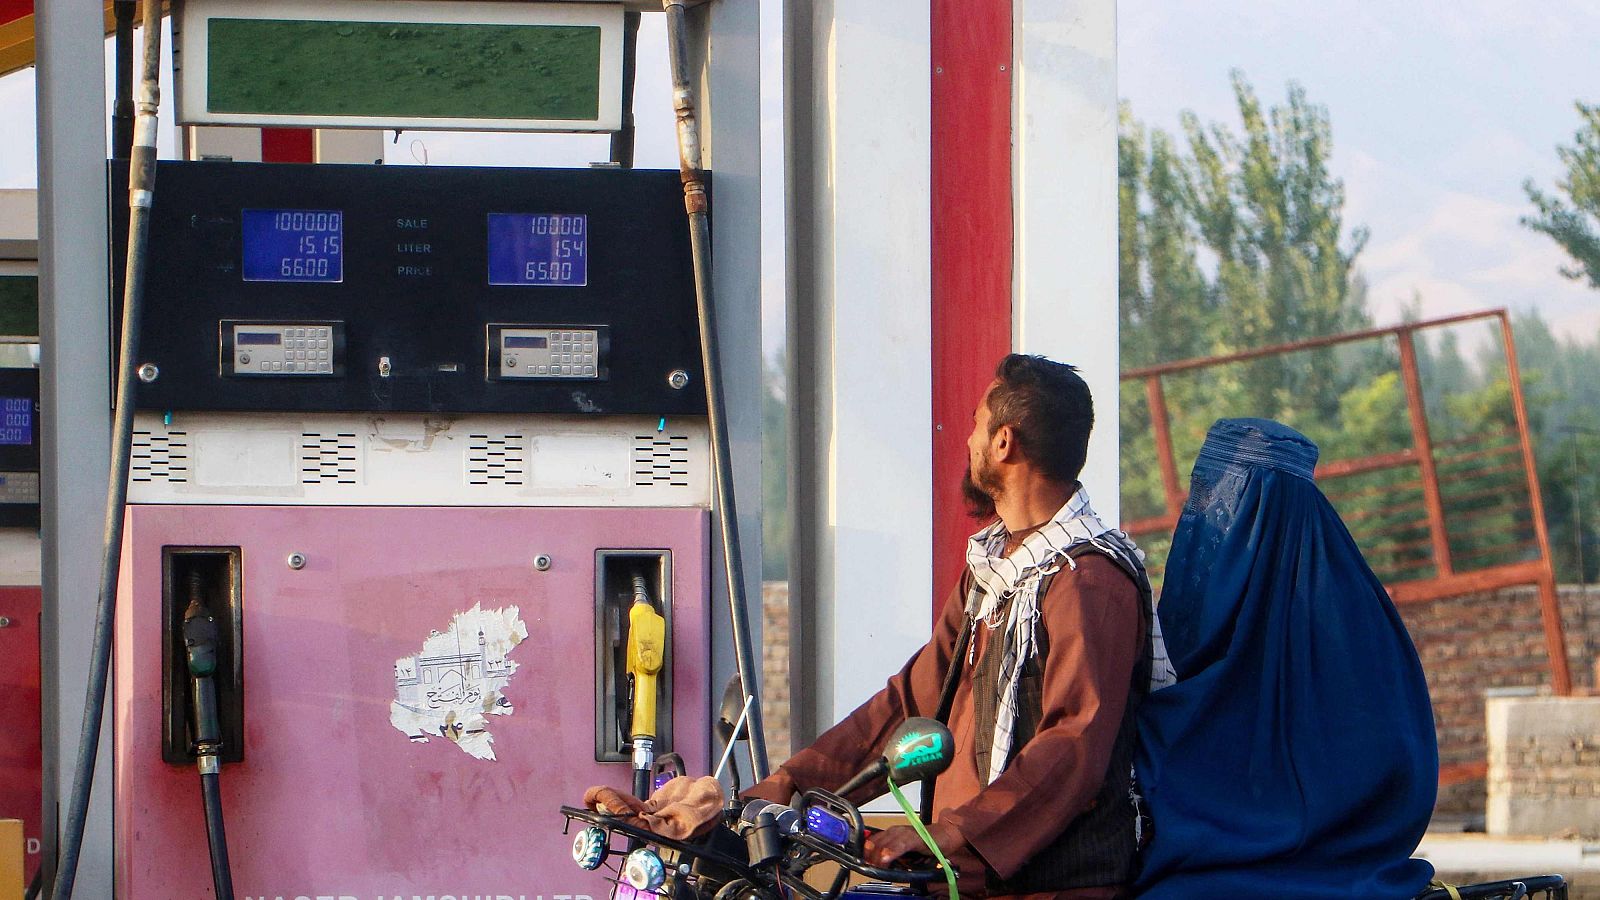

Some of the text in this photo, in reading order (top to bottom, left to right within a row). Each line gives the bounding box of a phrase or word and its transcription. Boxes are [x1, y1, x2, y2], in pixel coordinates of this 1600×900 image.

[397, 218, 428, 229] SALE
[300, 236, 339, 254] 15.15
[397, 243, 431, 254] LITER
[555, 240, 584, 257] 1.54
[397, 266, 433, 276] PRICE
[525, 262, 572, 280] 65.00
